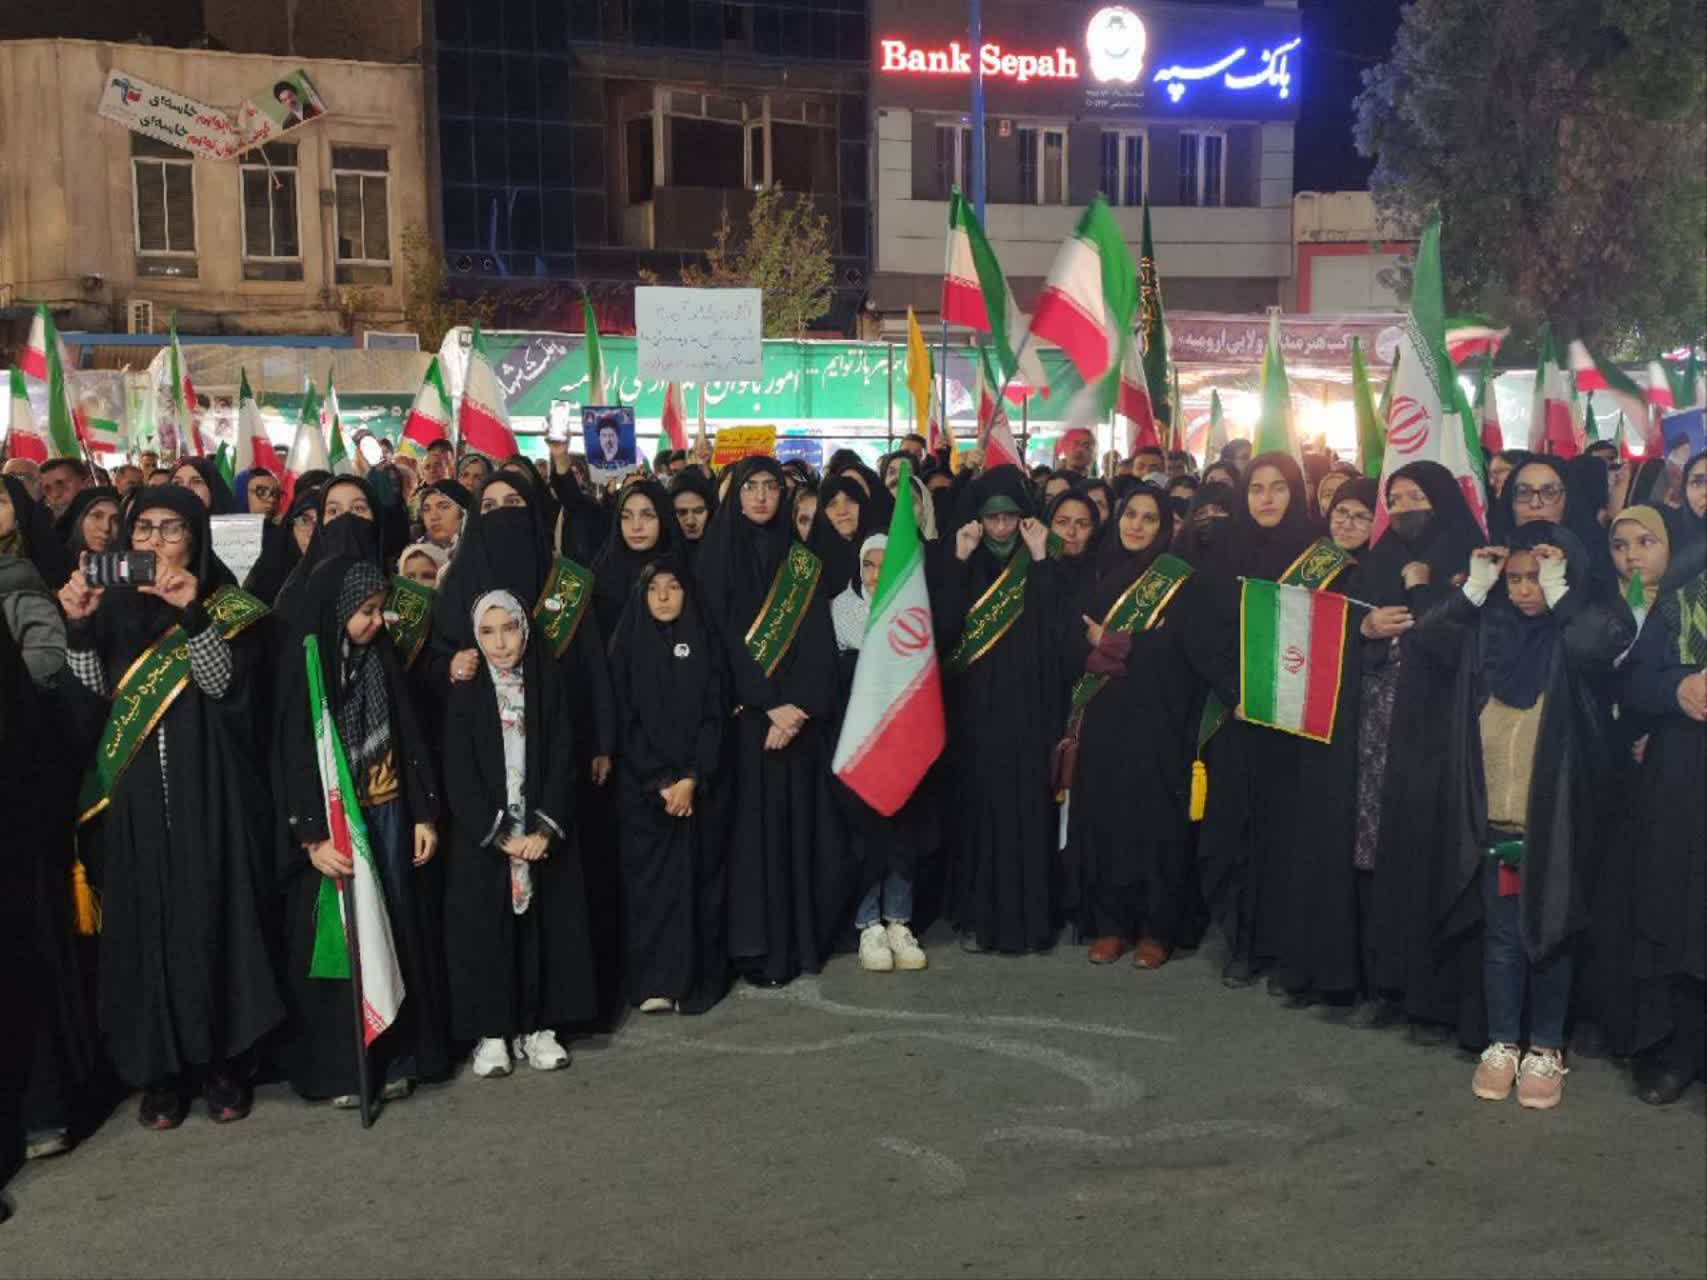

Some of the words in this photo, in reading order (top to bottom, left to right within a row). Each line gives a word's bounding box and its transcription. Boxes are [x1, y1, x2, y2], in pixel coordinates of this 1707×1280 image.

[881, 40, 971, 74] Bank
[979, 43, 1078, 80] Sepah
[1154, 47, 1247, 102] سپه
[1225, 37, 1302, 99] بانک
[560, 366, 619, 409] ارمیه
